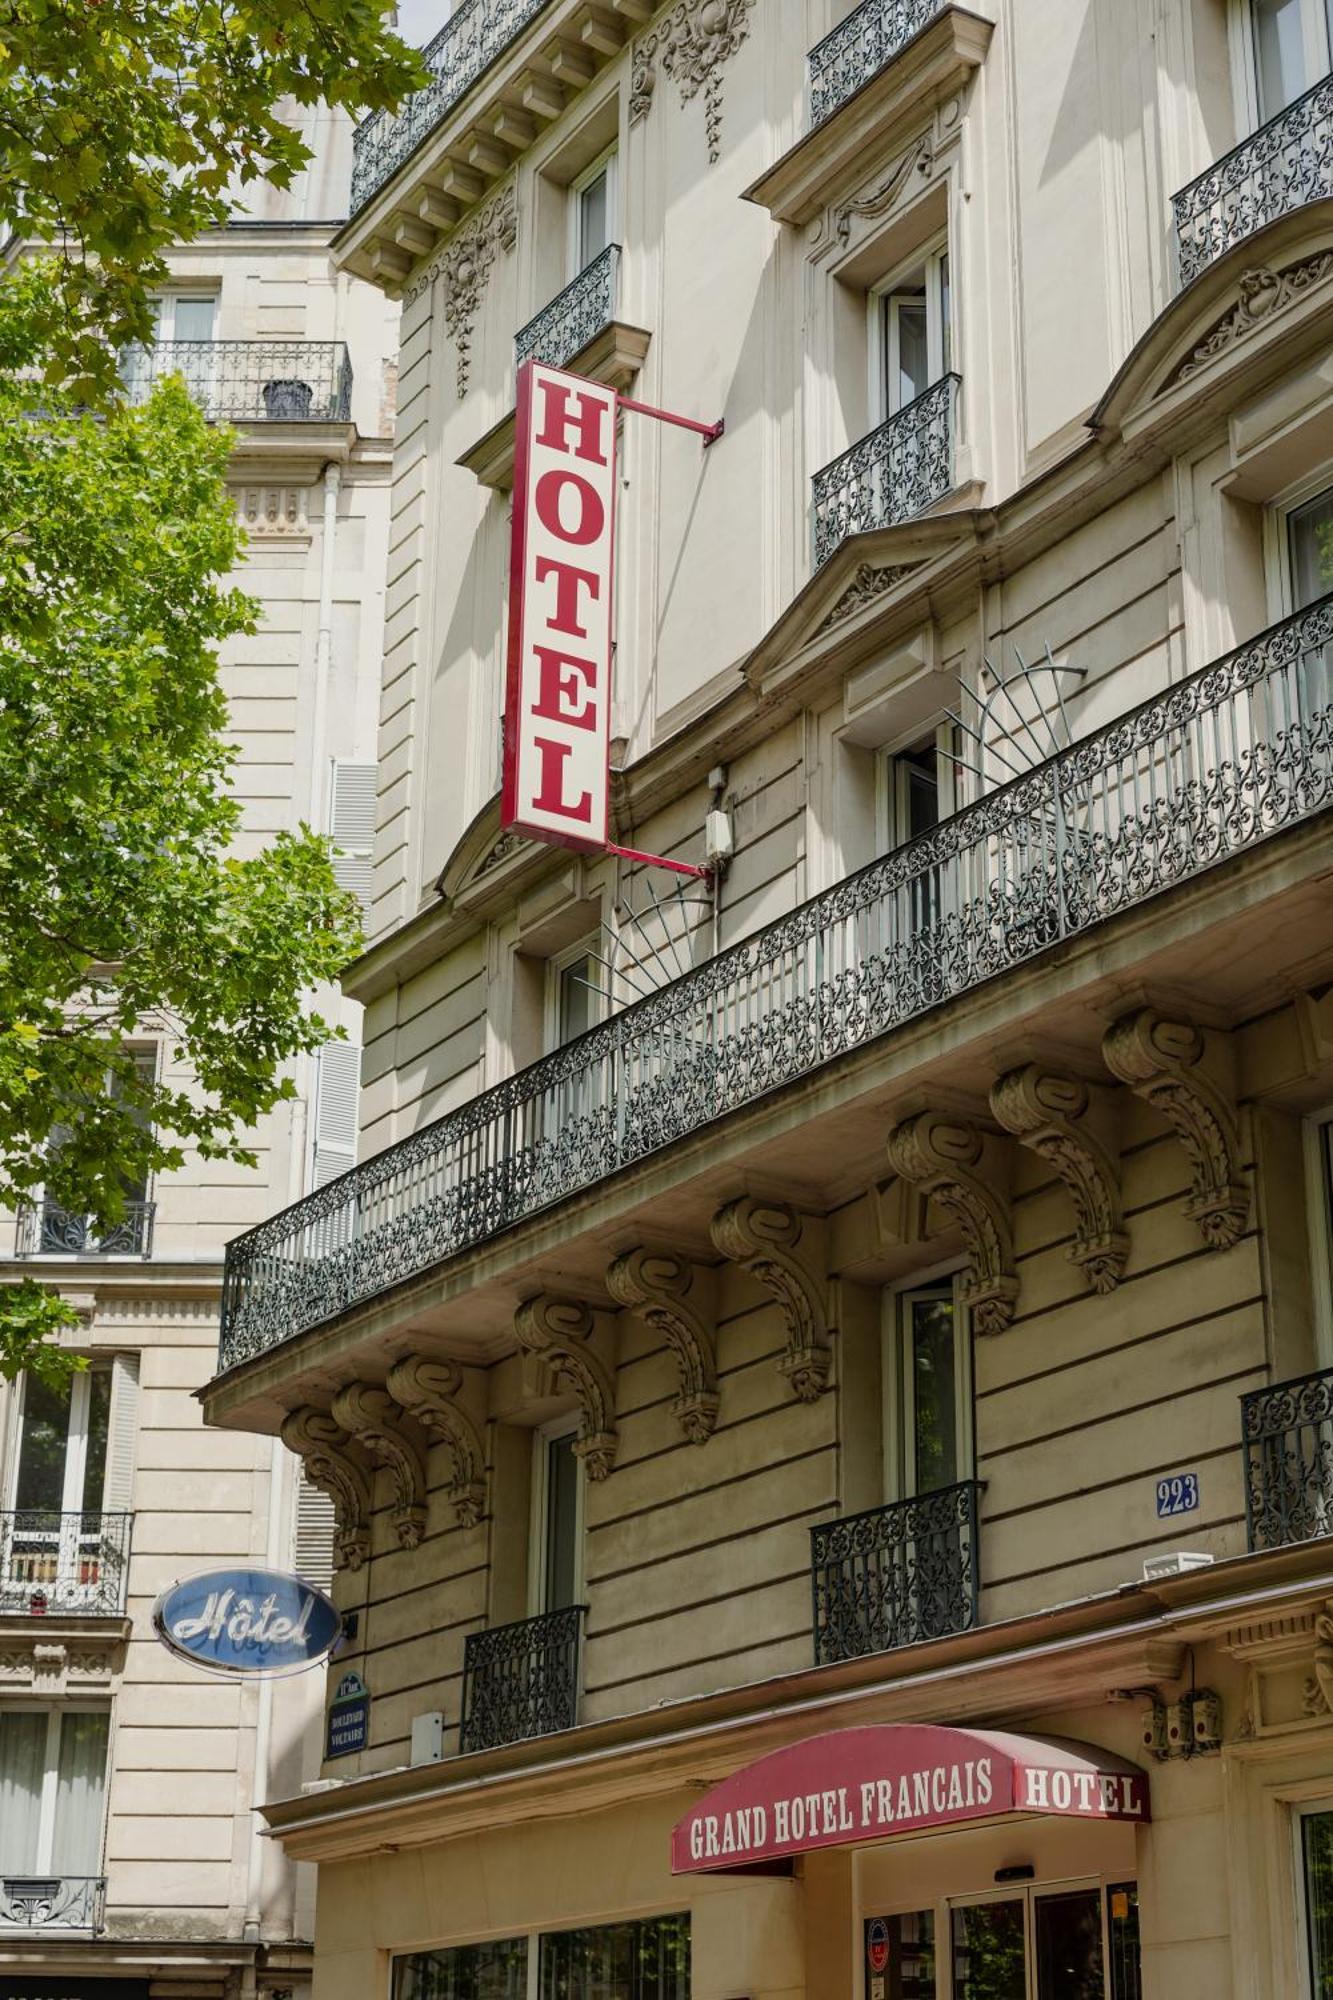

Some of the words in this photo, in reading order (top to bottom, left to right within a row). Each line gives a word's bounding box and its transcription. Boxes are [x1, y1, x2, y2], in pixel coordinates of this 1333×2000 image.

[531, 377, 609, 824] HOTEL
[1158, 1475, 1197, 1516] 223
[172, 1588, 316, 1646] Hôtel
[331, 1710, 365, 1730] BOULEVARD
[331, 1728, 364, 1747] VOLTAIRE
[690, 1805, 767, 1860] GRAND
[774, 1788, 854, 1843] HOTEL
[860, 1758, 993, 1827] FRANCAIS
[1025, 1768, 1142, 1815] HOTEL
